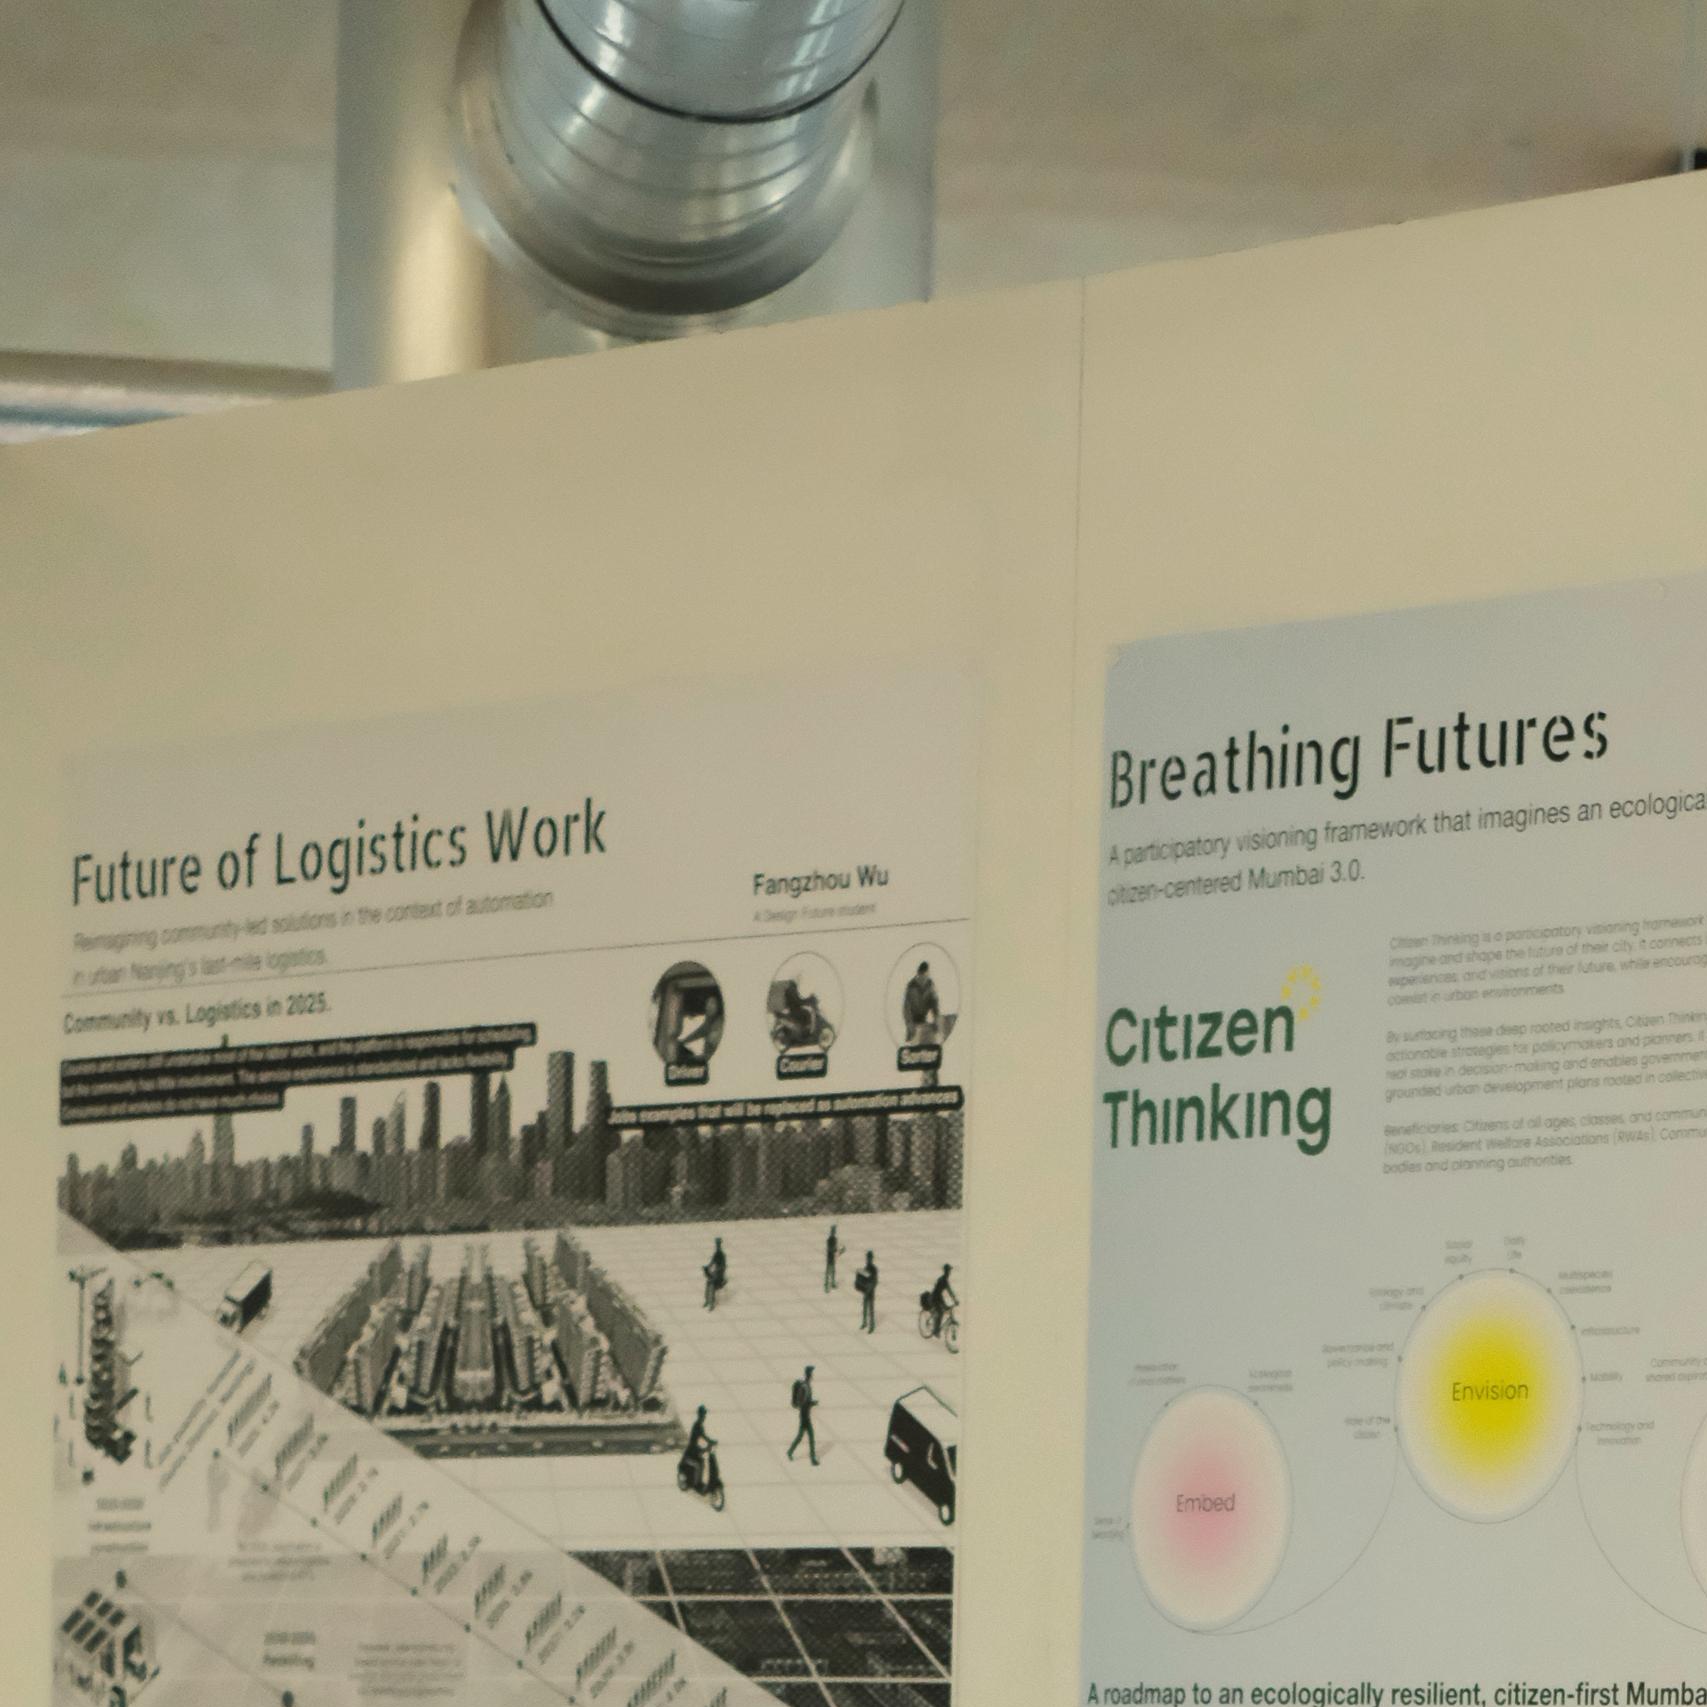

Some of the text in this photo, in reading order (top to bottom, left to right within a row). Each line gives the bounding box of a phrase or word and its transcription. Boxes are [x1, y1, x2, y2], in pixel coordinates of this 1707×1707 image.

[1110, 711, 1607, 808] Breathing Futures
[74, 797, 605, 906] Future of Logistics Work
[1108, 844, 1121, 868] A
[1124, 837, 1230, 864] participatory
[1236, 828, 1317, 851] visioning
[1324, 813, 1427, 842] framework
[1432, 810, 1471, 833] that
[1478, 805, 1570, 832] imagines
[1576, 802, 1602, 822] an
[754, 864, 888, 899] Fangzhou Wu
[1108, 858, 1365, 906] citizen-centered Mumbai 3.0.
[64, 991, 328, 1034] Community vs. Logistics in 2025.
[1106, 1005, 1294, 1066] Citizen
[1102, 1082, 1331, 1156] Thinking
[1452, 1380, 1528, 1401] Envision
[1176, 1494, 1235, 1513] Embed
[1088, 1683, 1100, 1705] A
[1192, 1683, 1212, 1705] to
[1219, 1687, 1244, 1705] an
[1494, 1681, 1619, 1706] citizen-first
